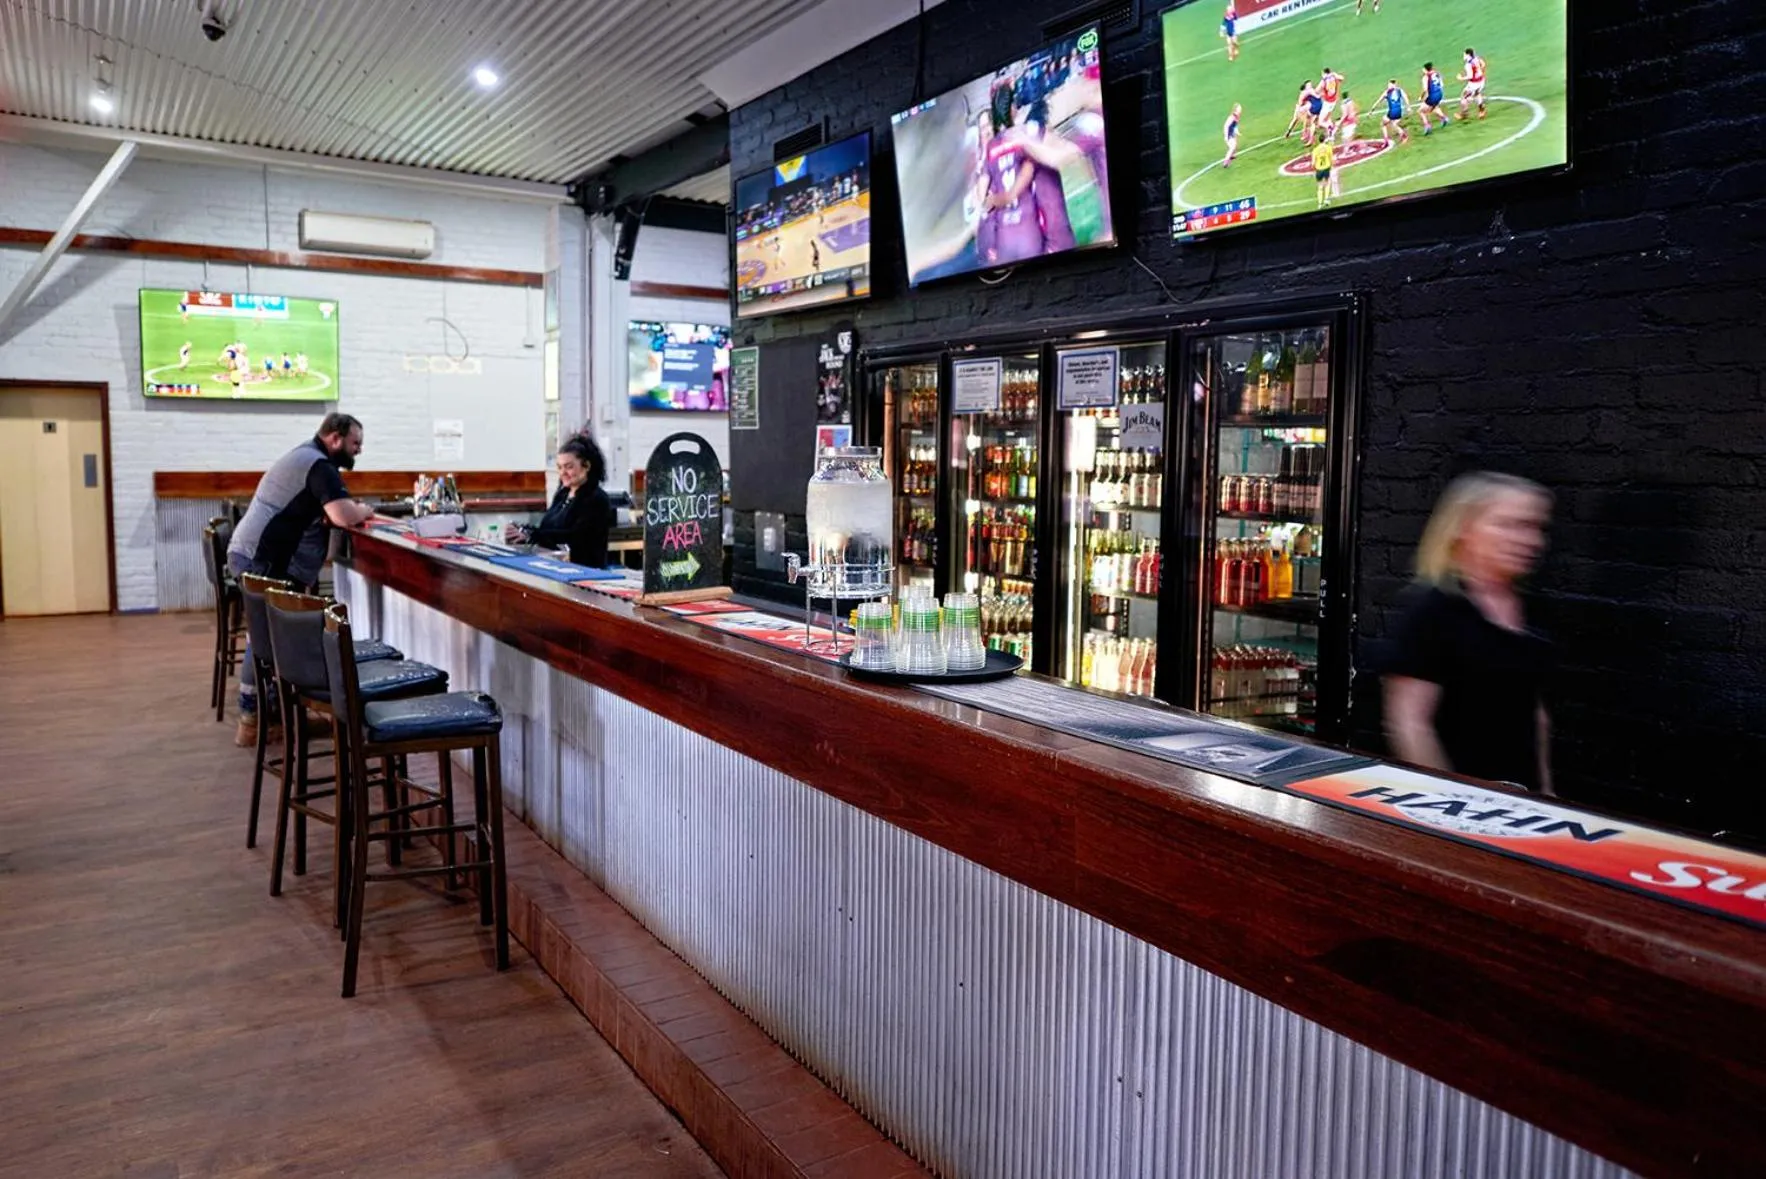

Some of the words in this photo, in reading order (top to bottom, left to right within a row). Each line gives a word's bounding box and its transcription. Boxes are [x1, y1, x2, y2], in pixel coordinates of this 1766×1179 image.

[1260, 10, 1280, 21] CAR
[1122, 416, 1138, 434] JIM
[1138, 411, 1162, 433] BEAM
[670, 465, 697, 495] NO
[646, 493, 719, 527] SERVICE
[662, 520, 703, 552] AREA
[1319, 578, 1328, 618] PULL
[1345, 785, 1625, 843] HAHN
